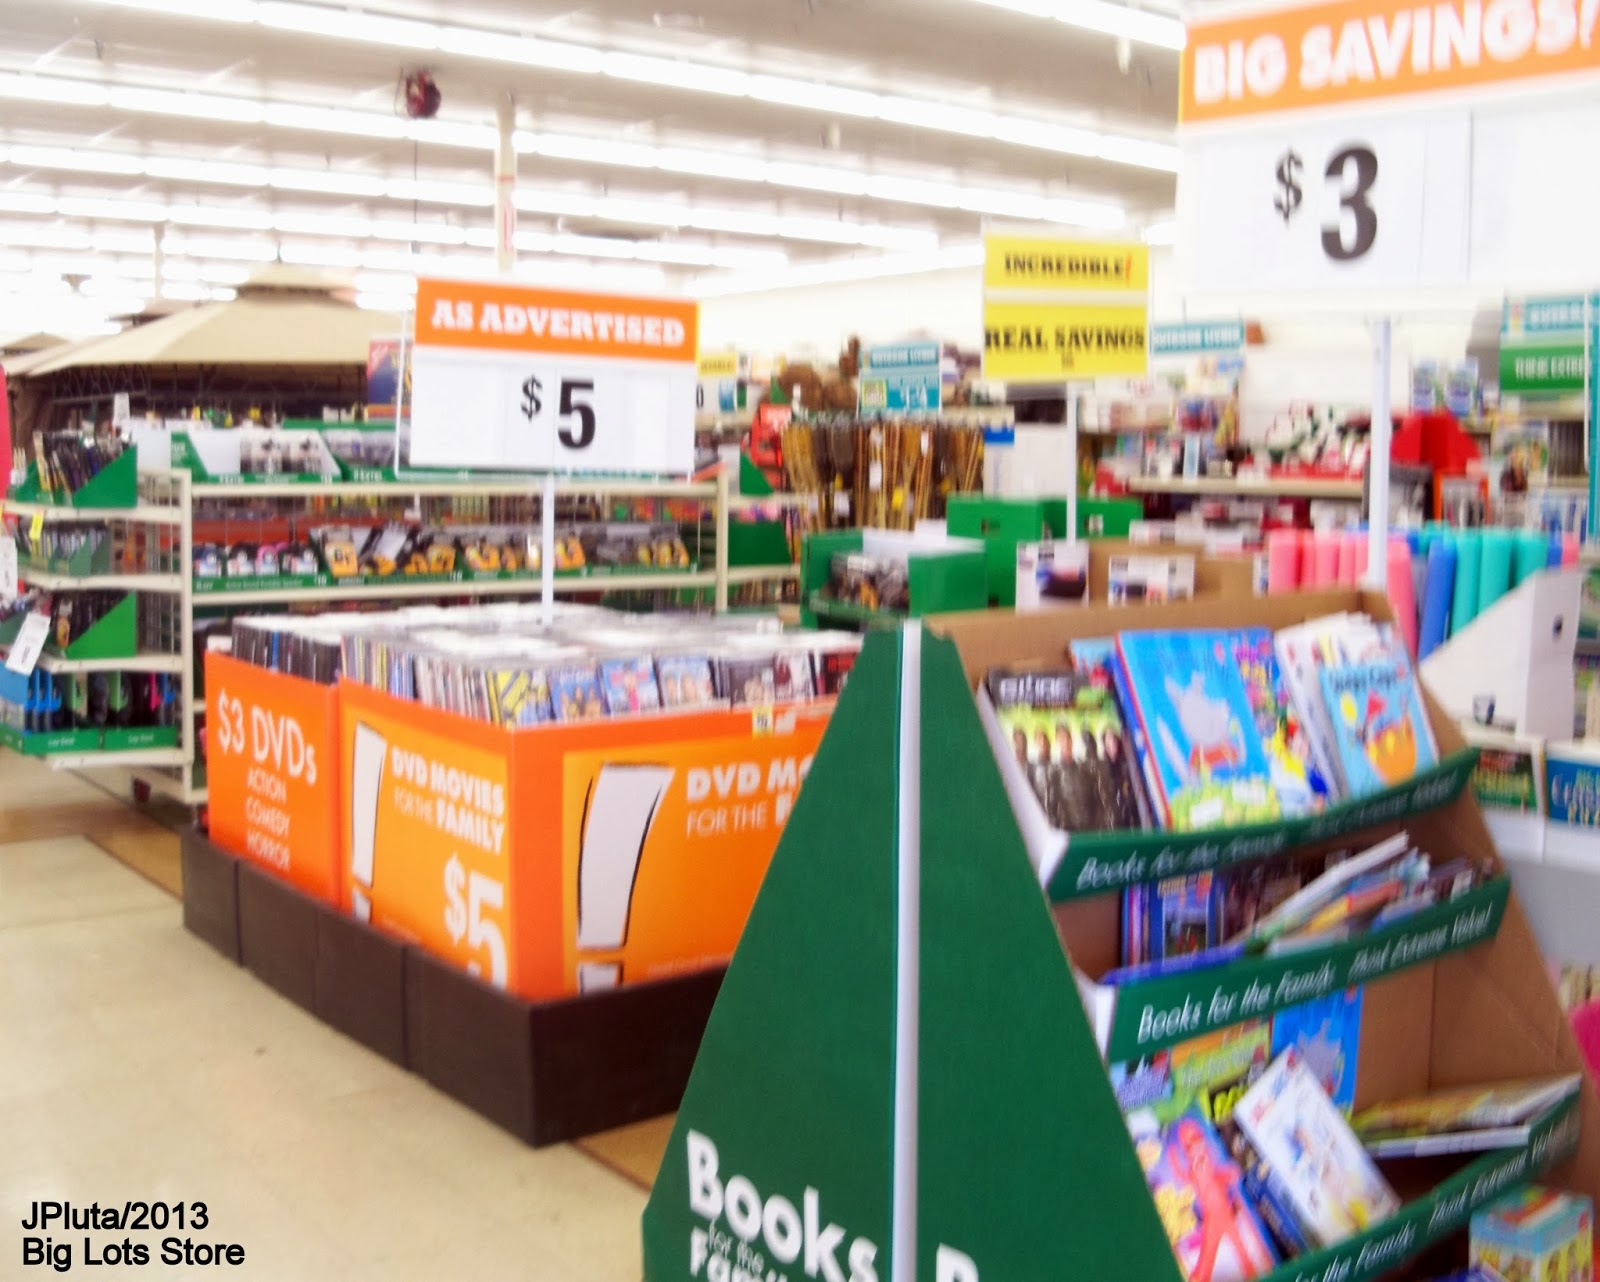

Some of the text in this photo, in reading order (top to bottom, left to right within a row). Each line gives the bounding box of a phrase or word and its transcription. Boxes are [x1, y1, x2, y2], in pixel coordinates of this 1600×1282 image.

[1194, 0, 1596, 105] BIG SAVINGS!
[1004, 252, 1132, 285] INCREDIBLE!
[431, 299, 686, 346] AS ADVERTISED
[984, 325, 1144, 350] REAL SAVINGS
[217, 688, 317, 786] $3 DVDs
[392, 745, 504, 818] DVD MOVIES
[686, 761, 761, 802] DVD
[436, 796, 505, 856] FAMILY
[686, 808, 727, 838] FOR
[734, 801, 767, 832] THE
[443, 852, 508, 992] $5
[1137, 992, 1201, 1045] Books
[1206, 985, 1238, 1027] for
[1240, 976, 1272, 1016] the
[686, 1127, 879, 1282] Books
